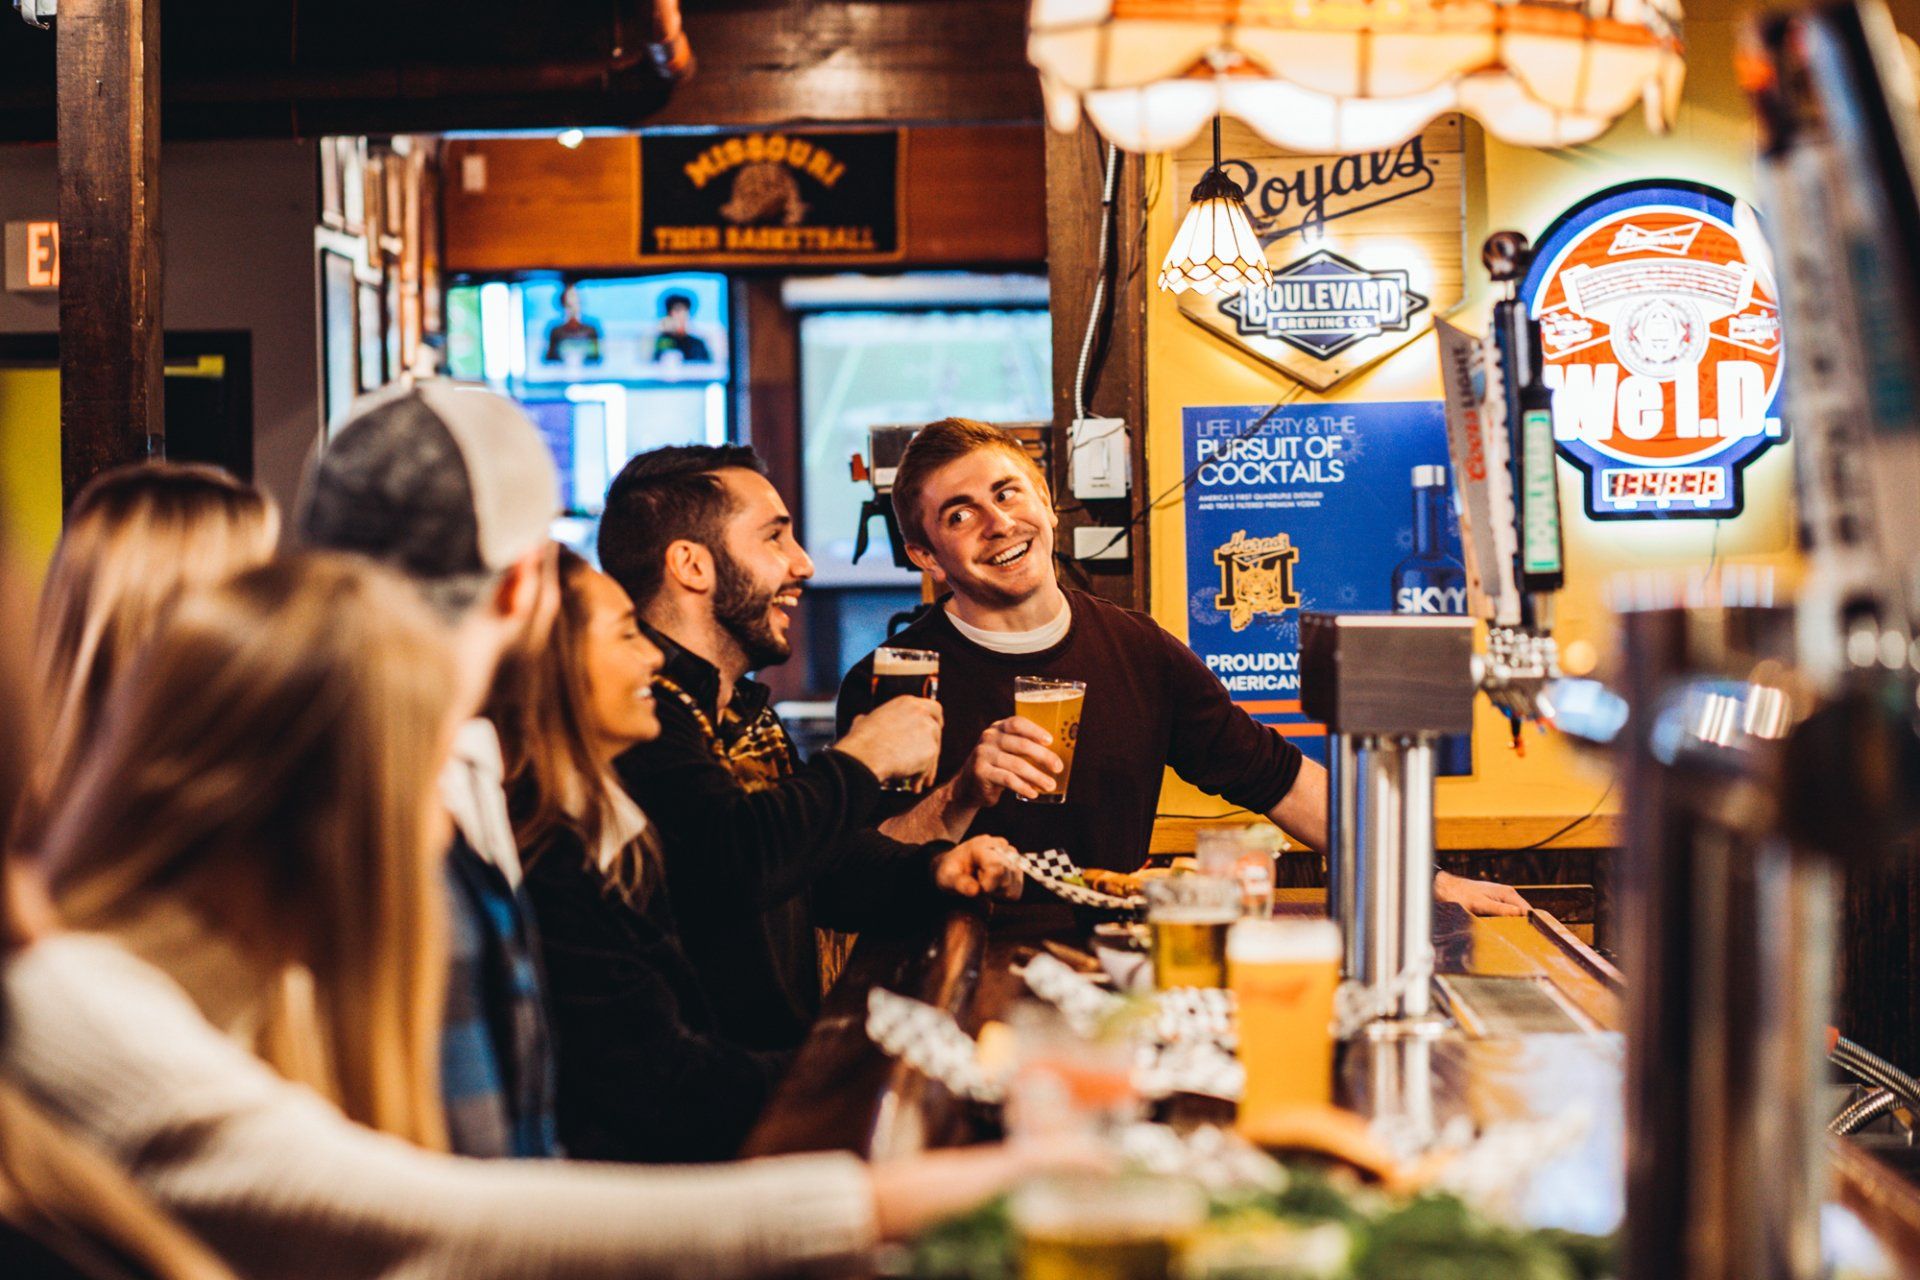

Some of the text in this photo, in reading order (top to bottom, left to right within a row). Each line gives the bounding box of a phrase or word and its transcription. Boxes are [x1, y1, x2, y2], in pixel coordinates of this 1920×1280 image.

[683, 135, 846, 188] MISSOURI
[1200, 134, 1434, 244] Royals
[1247, 280, 1400, 324] BOULEVARD
[1277, 316, 1345, 329] BREWING
[1542, 363, 1665, 441] We
[1305, 416, 1320, 435] &
[1320, 415, 1356, 434] THE
[1196, 435, 1343, 463] PURSUIT OF
[1197, 458, 1346, 487] COCKTAILS
[1396, 586, 1467, 613] SKYY
[1205, 652, 1300, 672] PROUDLY
[1220, 673, 1301, 691] MERICAN
